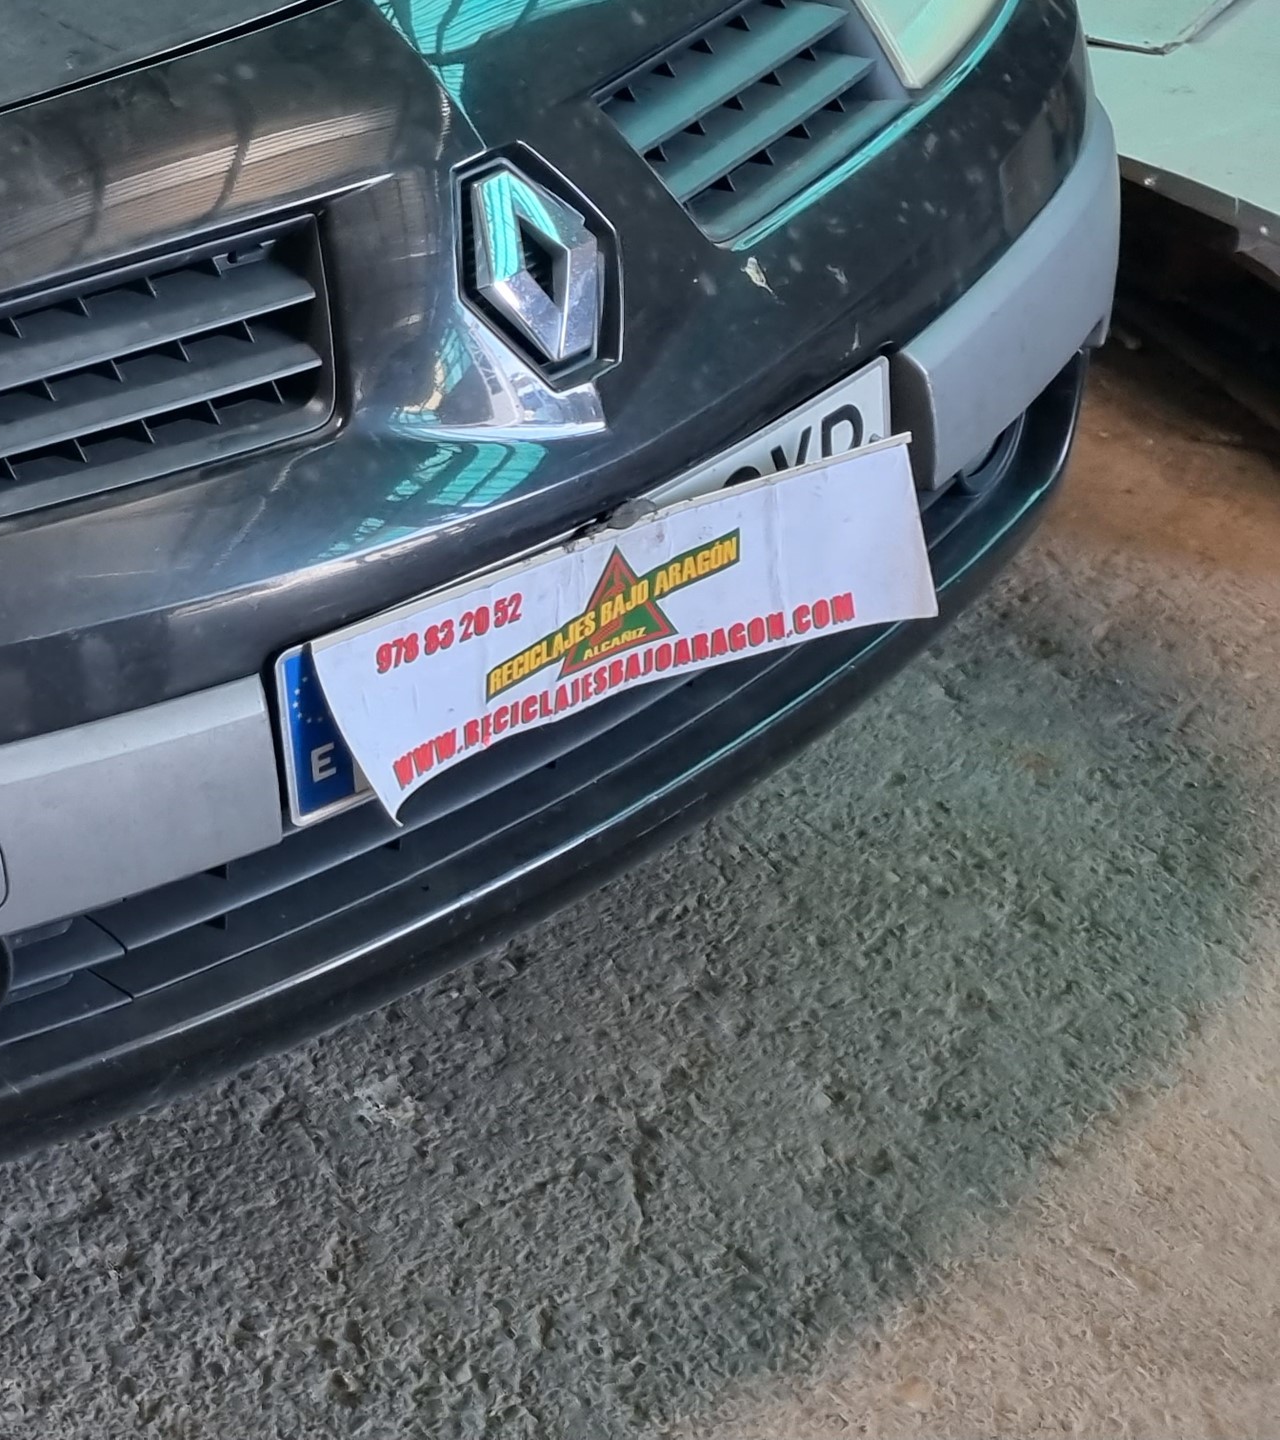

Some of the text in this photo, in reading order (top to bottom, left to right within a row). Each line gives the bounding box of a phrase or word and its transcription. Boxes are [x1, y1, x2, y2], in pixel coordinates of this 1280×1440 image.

[376, 592, 523, 675] 978 83 20 52
[489, 536, 738, 695] RECICLAJES BAJO ARAGÓN
[582, 625, 647, 662] ALCAÑIZ
[392, 592, 855, 791] WWW.RECICLAJESBAJOARAGON.COM
[310, 741, 338, 784] E
